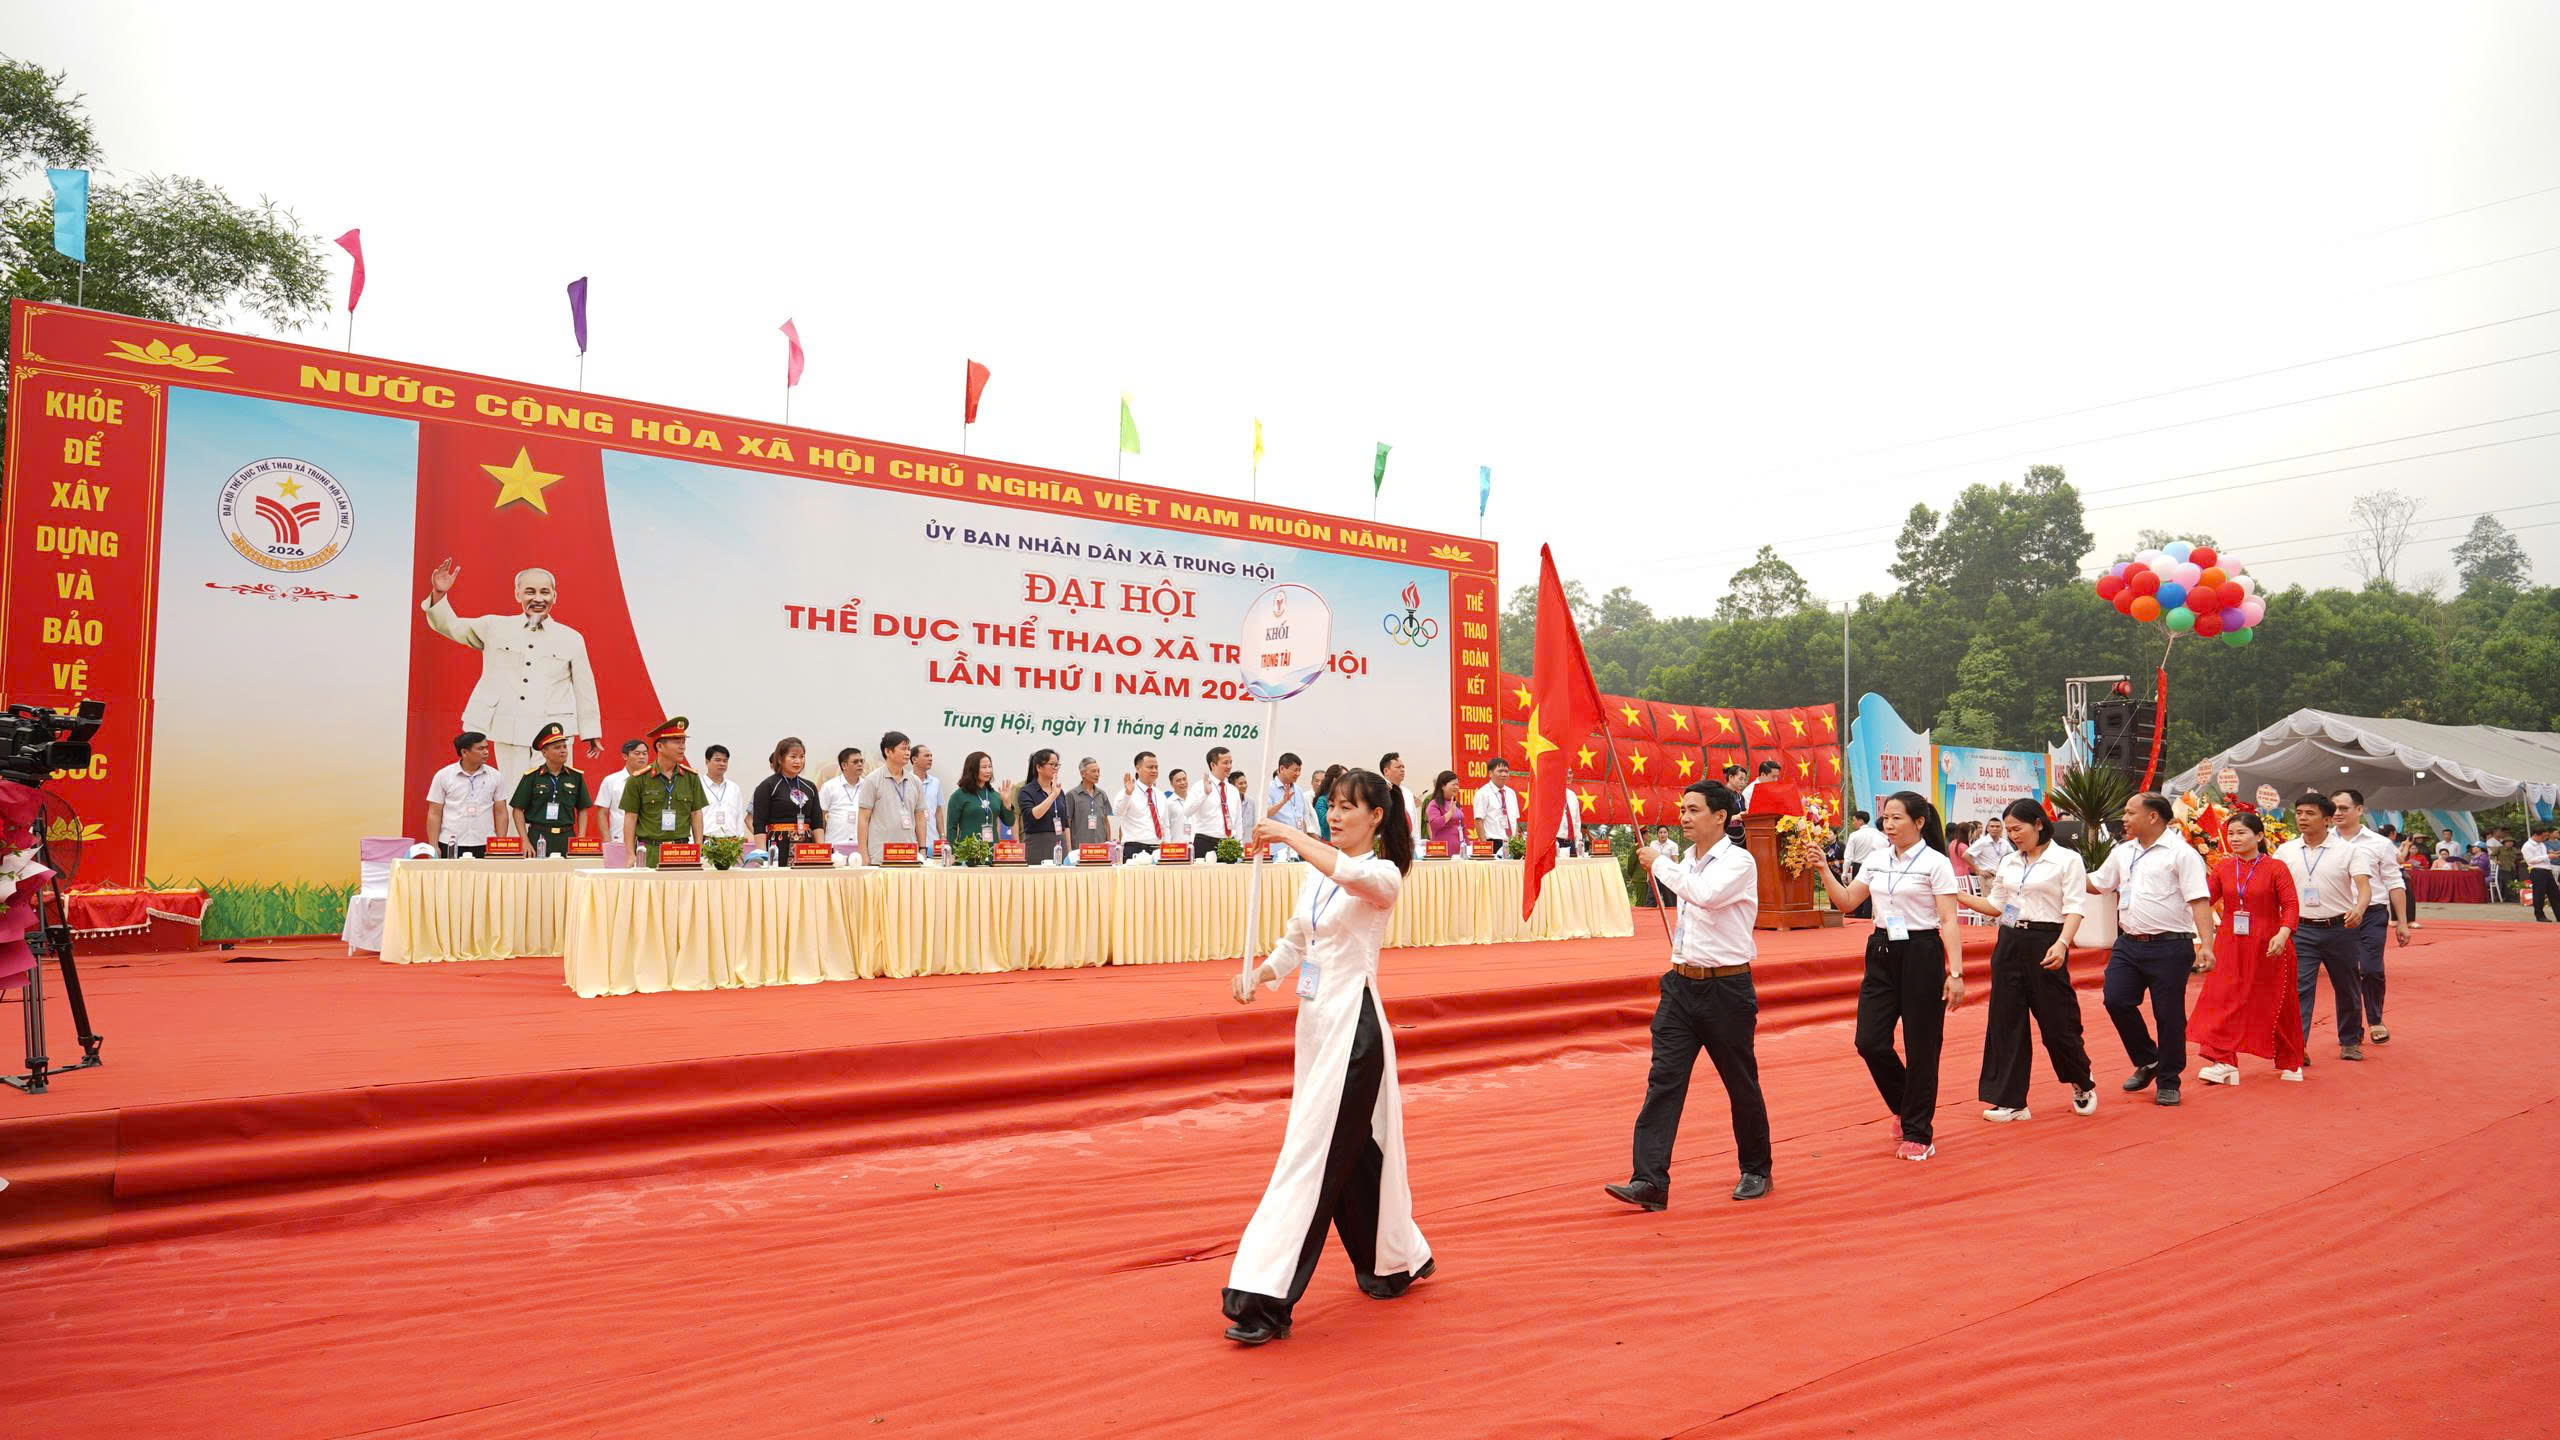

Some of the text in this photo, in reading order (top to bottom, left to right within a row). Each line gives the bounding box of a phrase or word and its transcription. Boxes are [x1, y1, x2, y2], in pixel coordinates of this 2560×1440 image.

[46, 388, 123, 425] KHỎE
[64, 431, 104, 467] ĐỂ
[300, 365, 1408, 553] NƯỚC CỘNG HÒA XÃ HỘI CHỦ NGHĨA VIỆT NAM MUÔN NĂM!
[256, 462, 271, 473] THỂ
[272, 462, 293, 470] THAO
[307, 468, 331, 487] TRUNG
[50, 478, 110, 512] XÂY
[36, 525, 119, 560] DỰNG
[267, 545, 304, 556] 2026
[925, 518, 1275, 582] ỦY BAN NHÂN DÂN XÃ TRUNG HỘI
[57, 568, 95, 600] VÀ
[1024, 573, 1197, 623] ĐẠI HỘI
[1466, 590, 1484, 612] THỂ
[42, 610, 103, 646] BẢO
[784, 598, 862, 634] THỂ
[873, 613, 960, 646] DỤC
[972, 615, 1038, 648] THỂ
[1048, 628, 1142, 656] THAO
[1153, 636, 1200, 661] XÃ
[1265, 620, 1289, 641] KHỐI
[1463, 622, 1487, 640] THAO
[1261, 652, 1279, 671] TRỌNG
[1280, 649, 1291, 667] TÀI
[1462, 648, 1489, 667] ĐOÀN
[52, 658, 89, 697] VỆ
[929, 650, 1001, 687] LẦN
[1014, 664, 1083, 692] THỨ
[1094, 673, 1102, 692] I
[1114, 670, 1190, 697] NĂM
[1467, 674, 1485, 694] KẾT
[944, 711, 1259, 739] Trung Hội, ngày 11 tháng 4 năm 2026
[1460, 705, 1492, 723] TRUNG
[1464, 733, 1489, 754] THỰC
[1468, 761, 1487, 777] CAO
